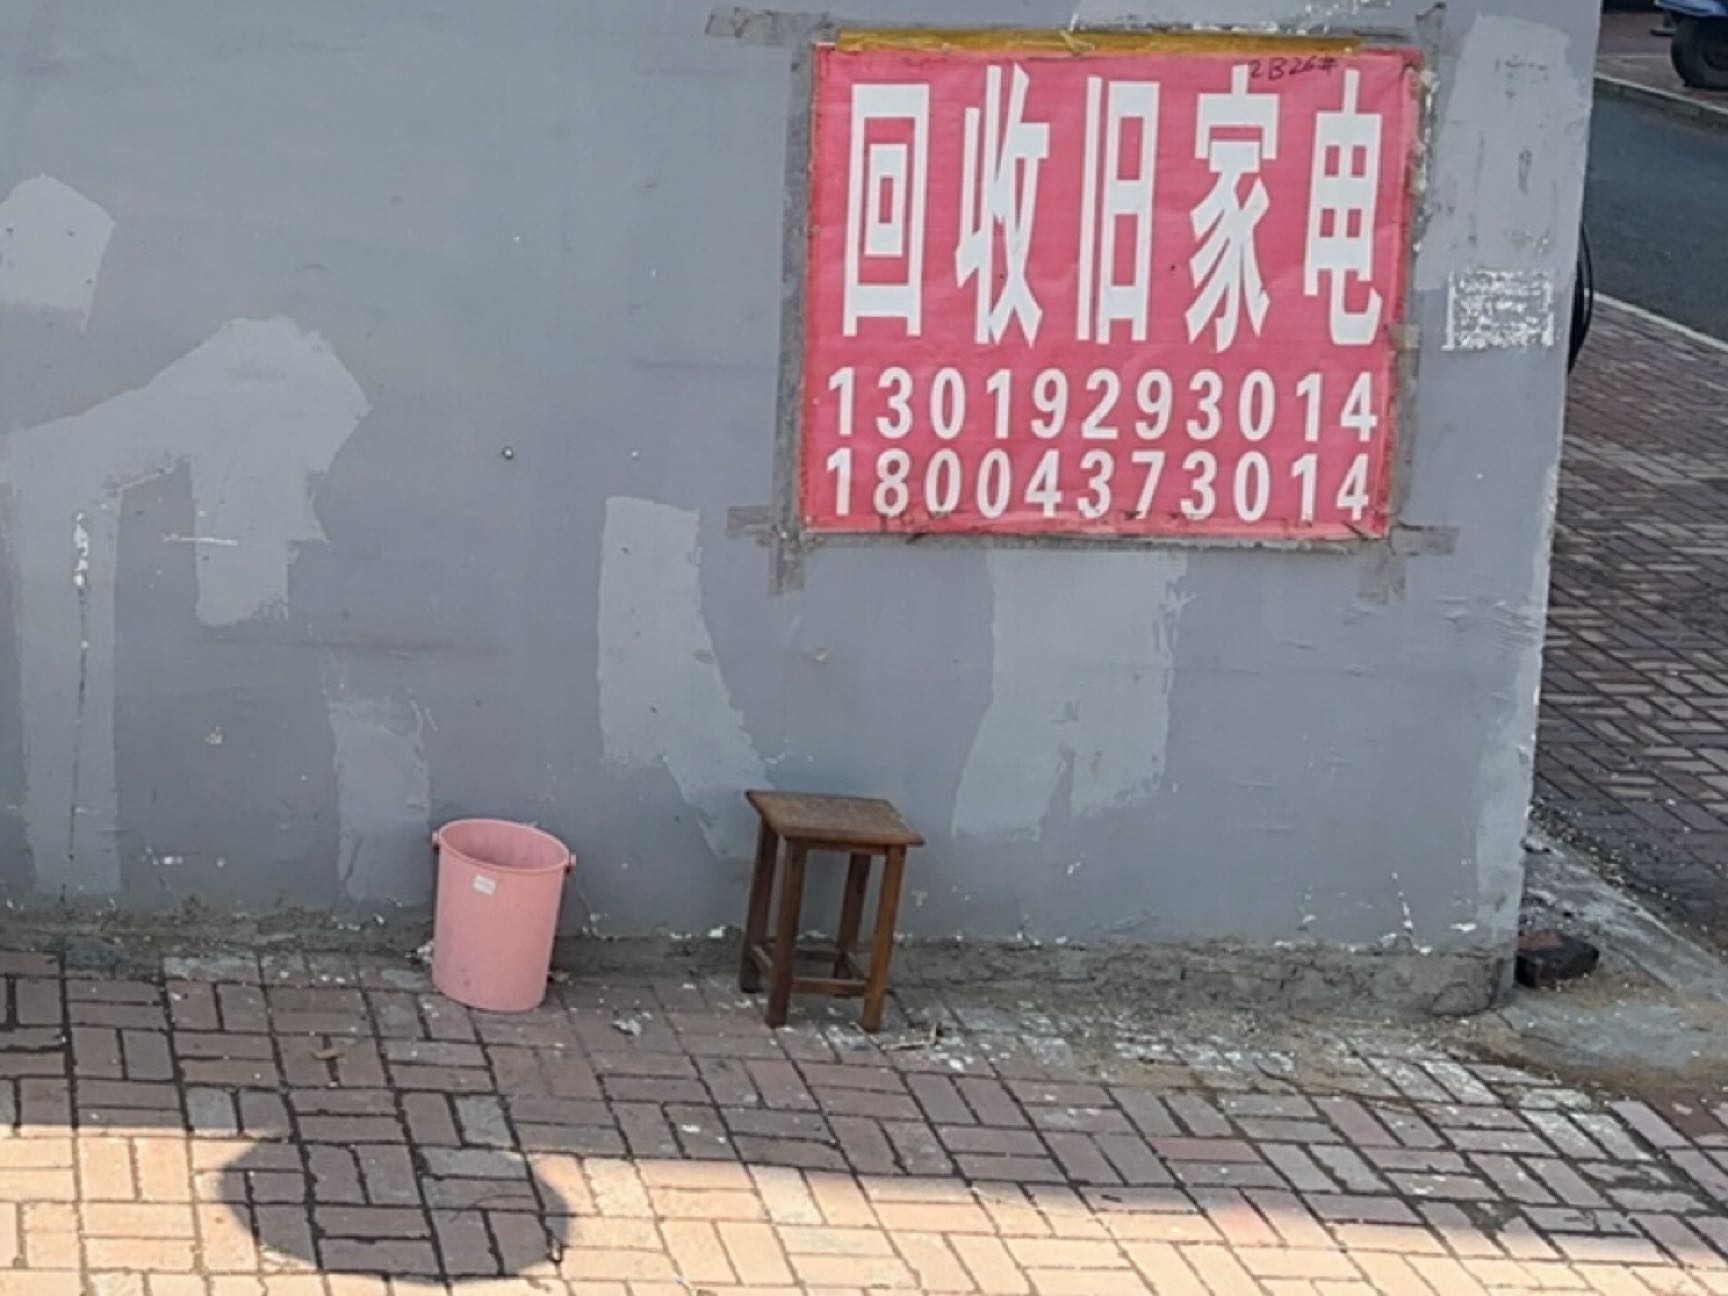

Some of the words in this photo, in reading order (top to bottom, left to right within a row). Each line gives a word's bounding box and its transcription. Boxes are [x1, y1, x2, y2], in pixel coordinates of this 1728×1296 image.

[842, 62, 1383, 353] 回收旧家电
[828, 366, 1378, 444] 13019293014
[825, 447, 1370, 522] 18004373014
